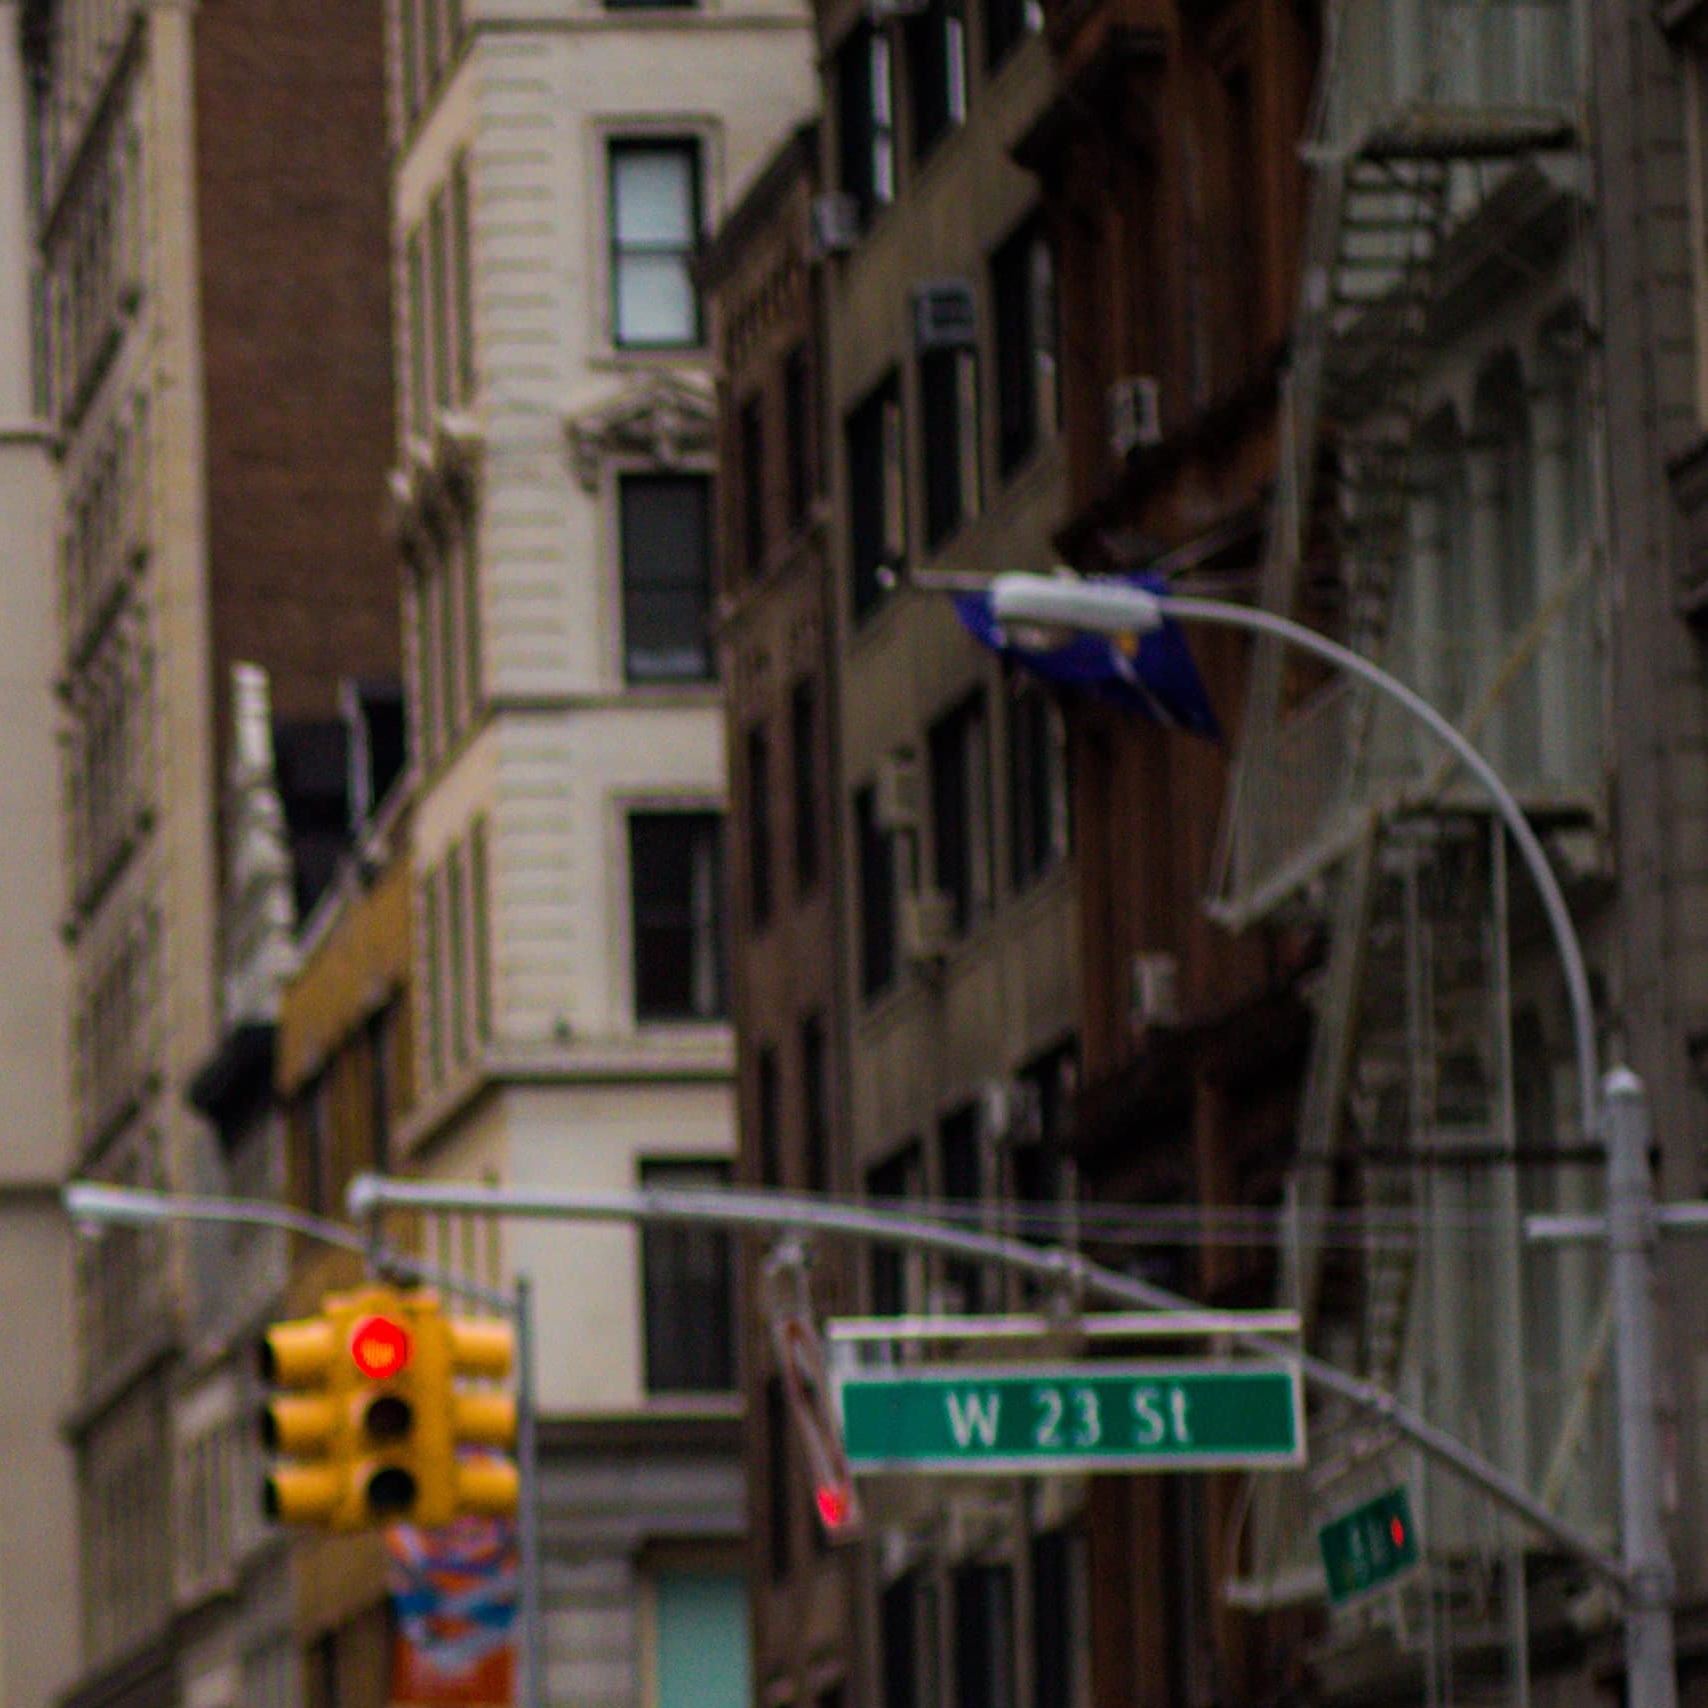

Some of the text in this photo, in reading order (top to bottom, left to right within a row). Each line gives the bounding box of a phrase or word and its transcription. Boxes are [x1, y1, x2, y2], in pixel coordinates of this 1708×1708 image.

[946, 1388, 1190, 1447] W 23 St
